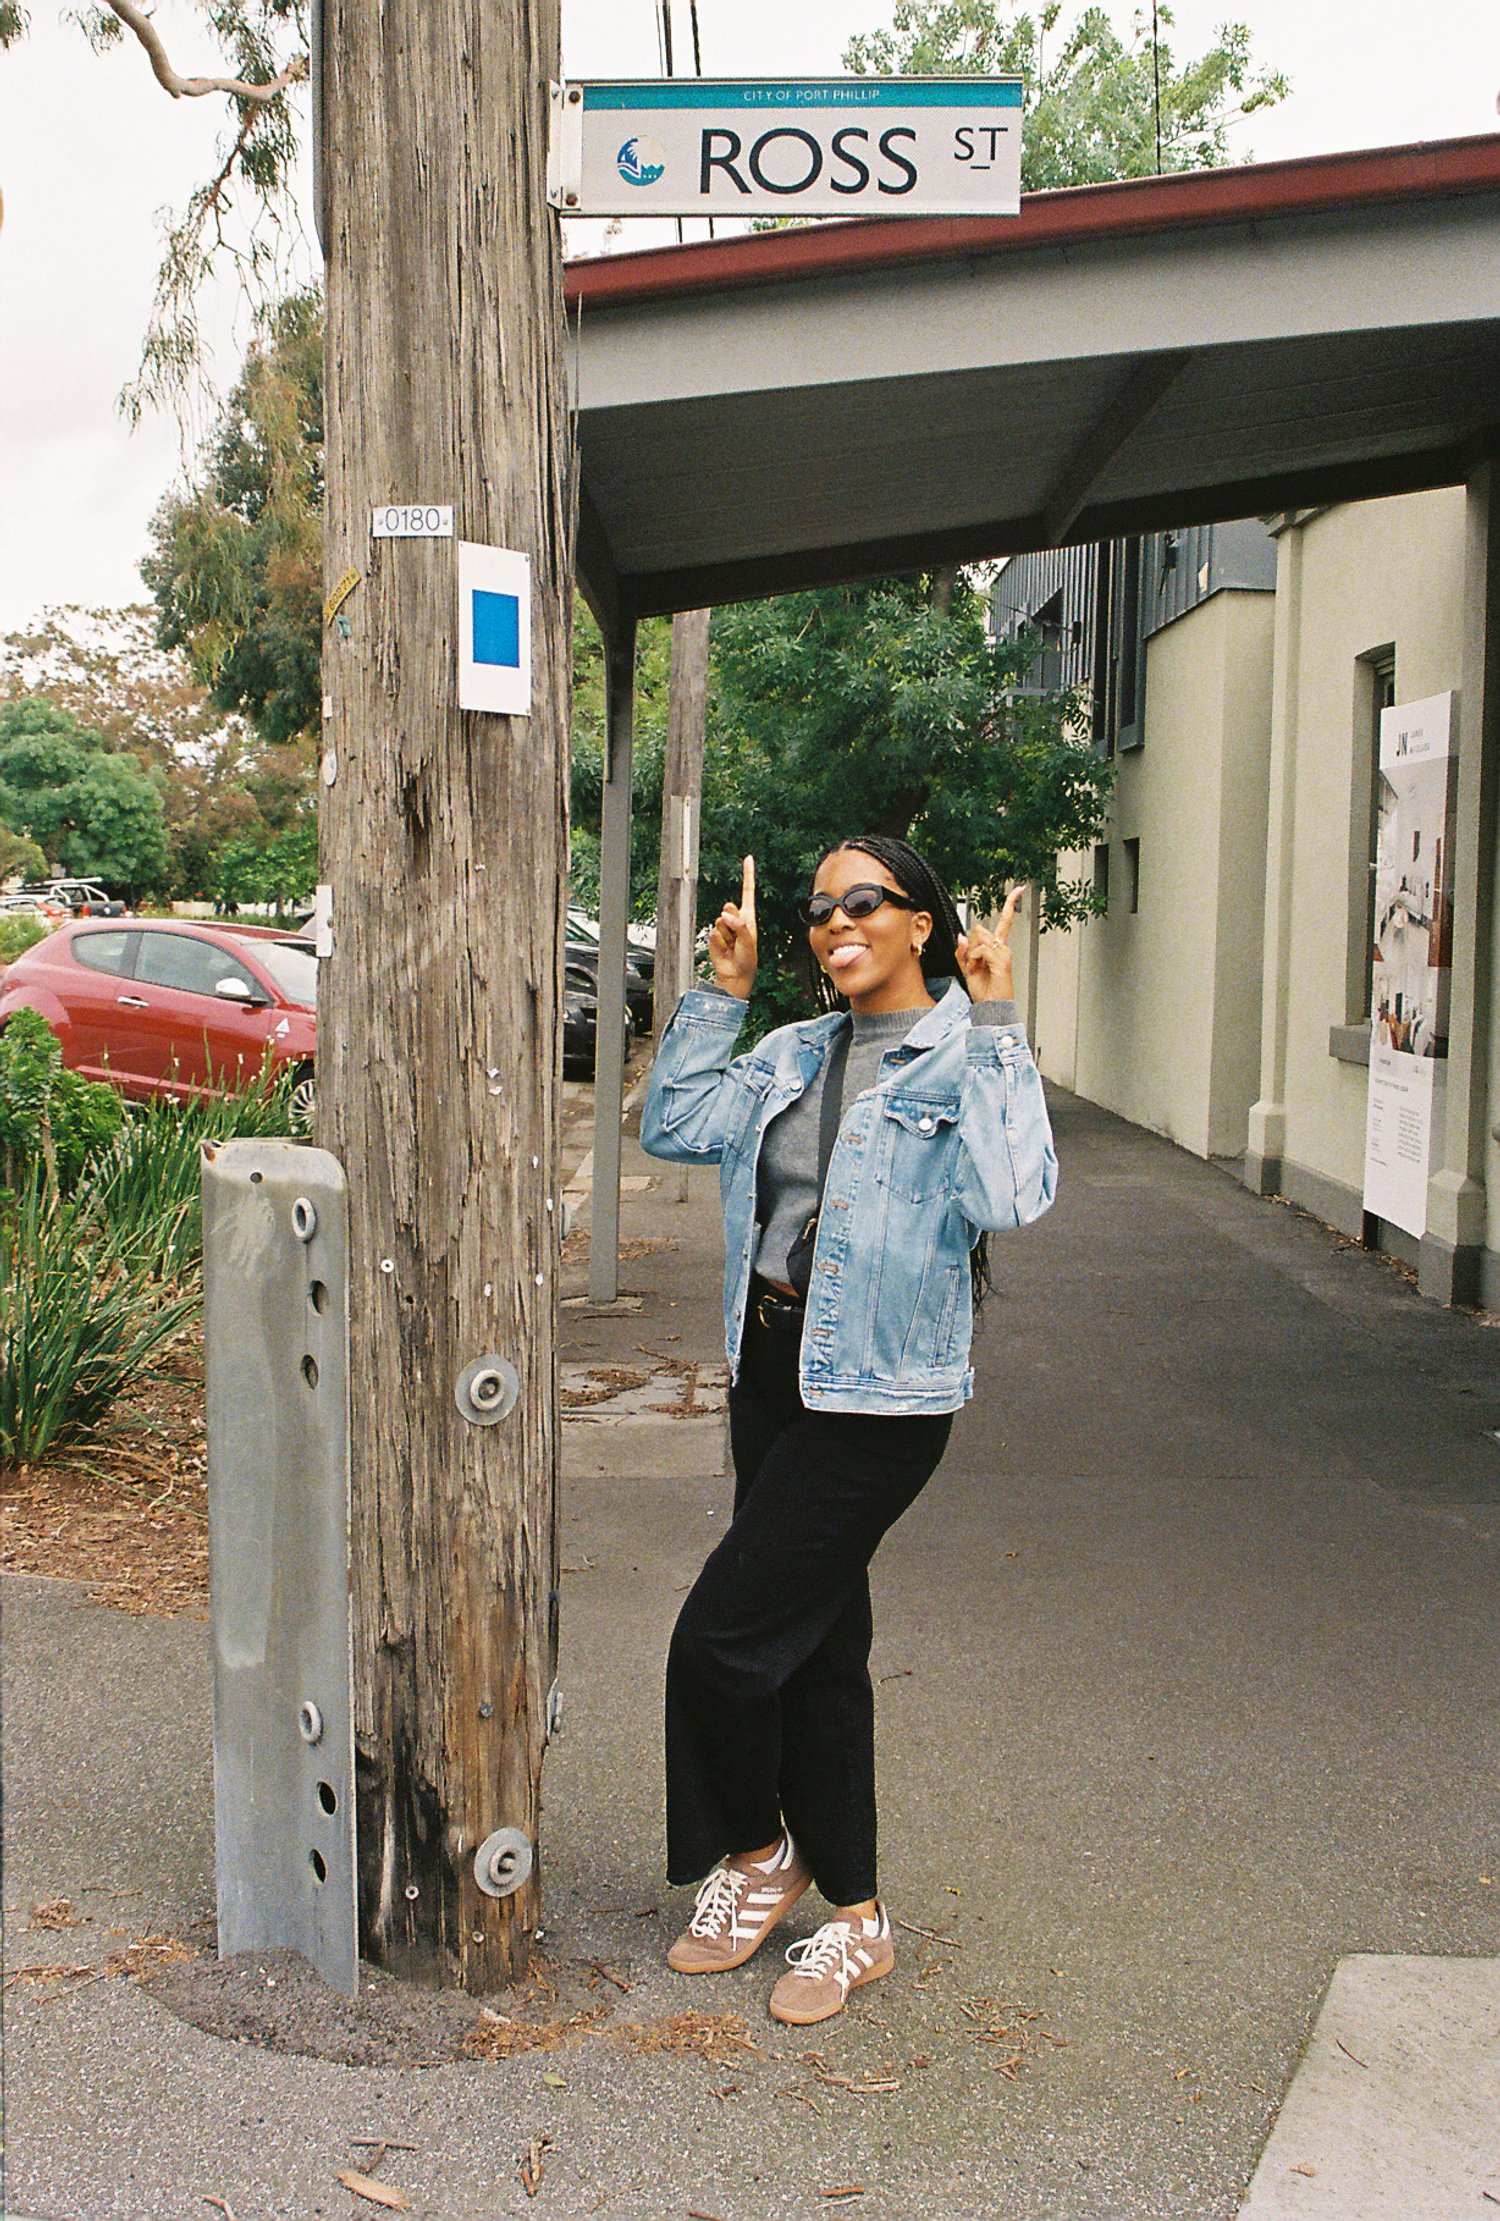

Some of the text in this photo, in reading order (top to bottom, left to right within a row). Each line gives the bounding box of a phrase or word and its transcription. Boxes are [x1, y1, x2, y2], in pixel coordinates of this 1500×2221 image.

[744, 89, 880, 101] CITY OF PORT PHILLIP
[700, 127, 1008, 195] ROSS ST
[385, 508, 440, 531] 0180
